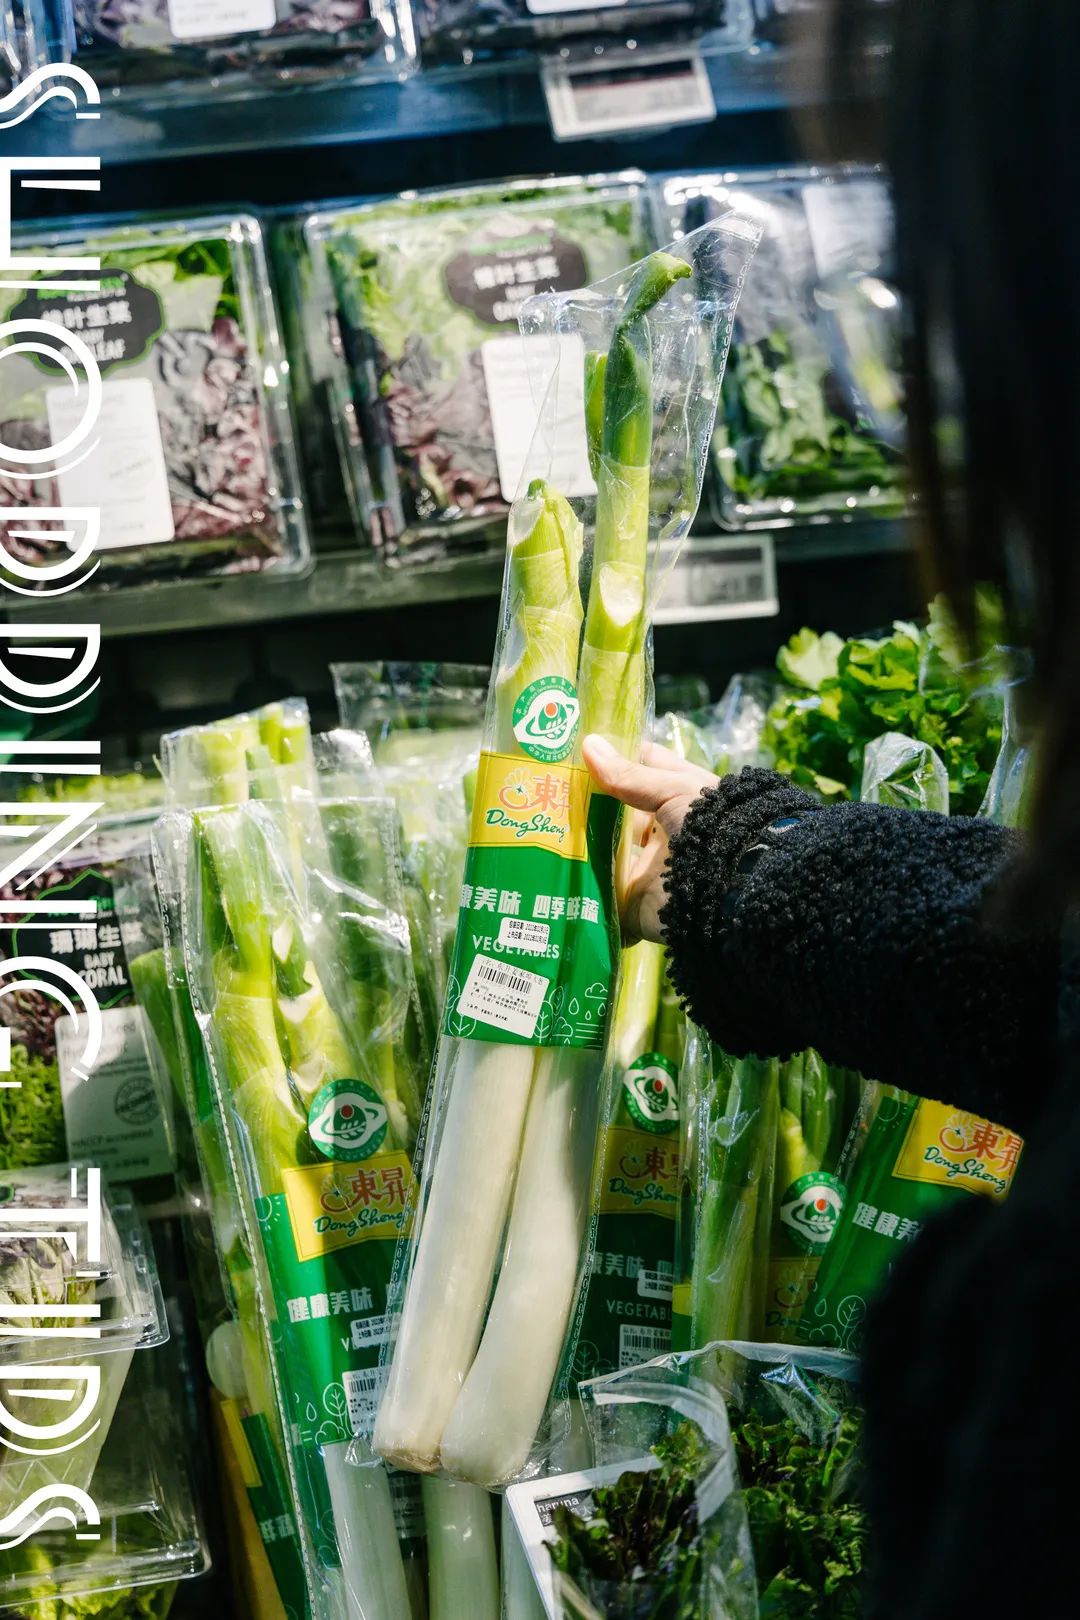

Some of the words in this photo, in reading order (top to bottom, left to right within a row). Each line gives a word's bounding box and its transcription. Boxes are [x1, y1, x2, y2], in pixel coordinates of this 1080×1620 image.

[486, 809, 569, 843] DongSheng
[923, 1146, 1006, 1193] DongSheng
[314, 1207, 406, 1238] DongSheng
[287, 1286, 374, 1324] 健康美味
